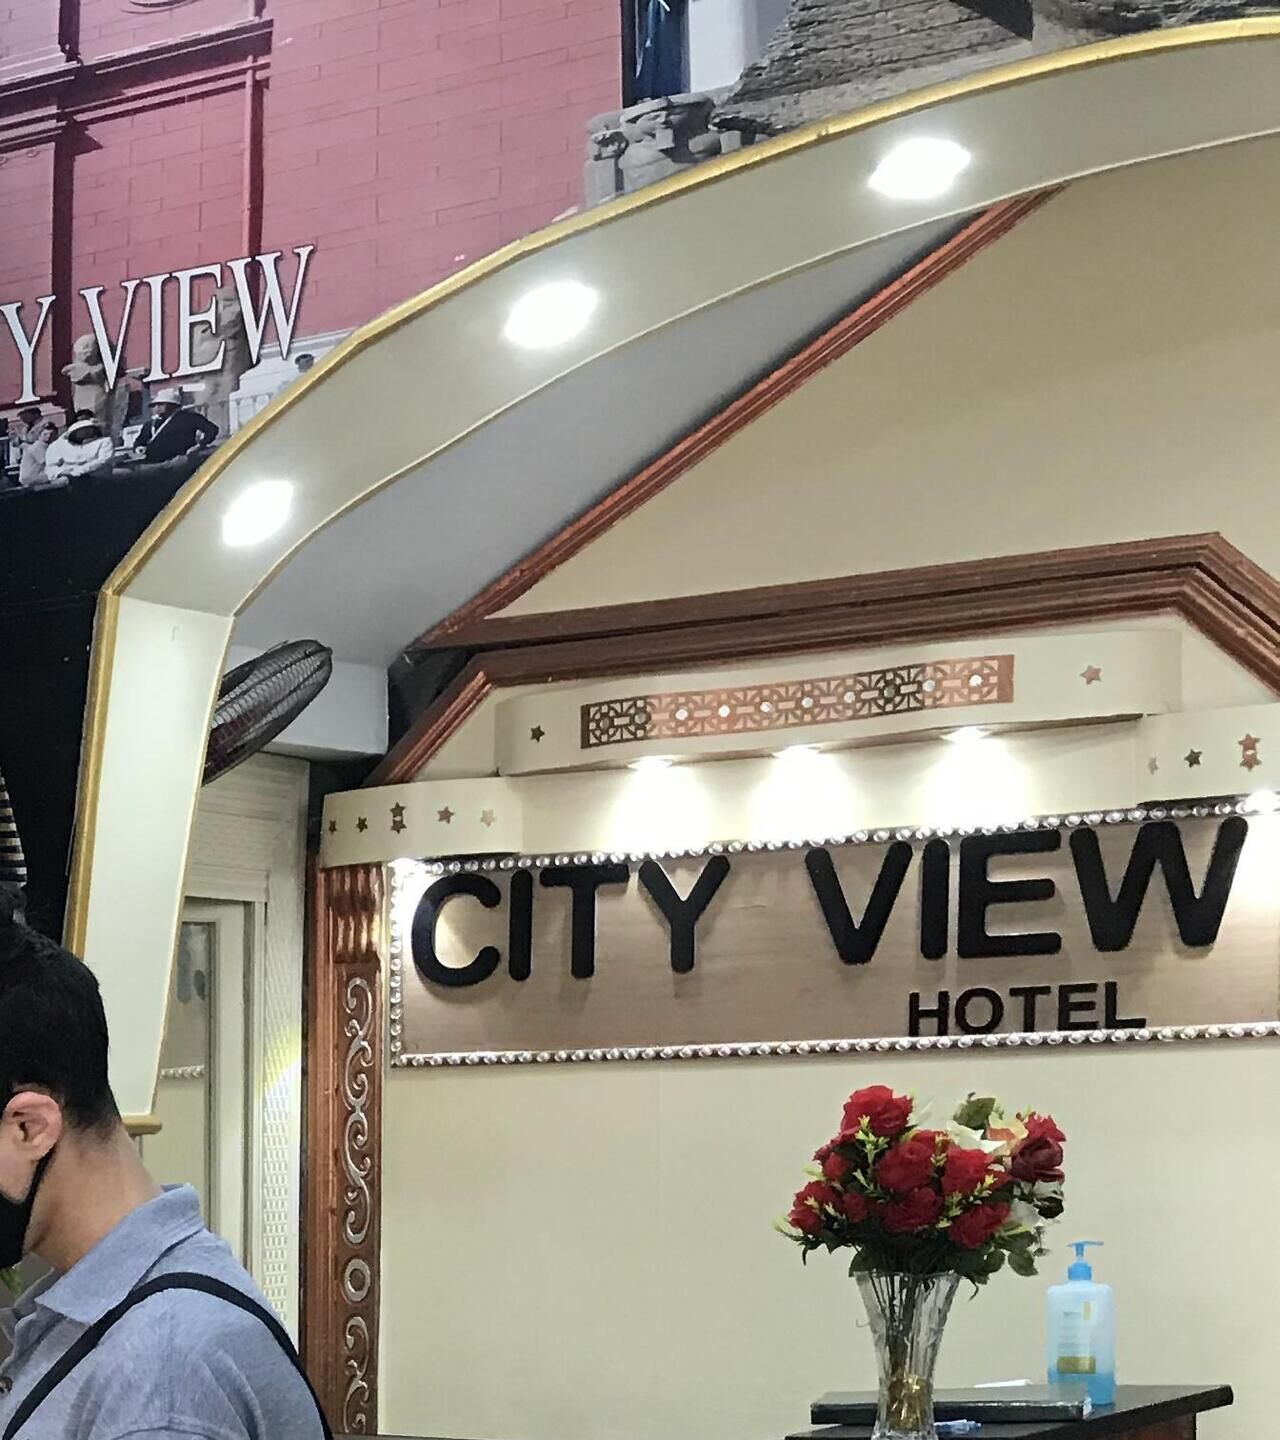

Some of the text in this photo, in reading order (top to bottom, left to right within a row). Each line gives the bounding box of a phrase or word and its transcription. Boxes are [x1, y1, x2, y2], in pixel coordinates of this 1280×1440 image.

[80, 245, 316, 392] VIEW
[411, 817, 1248, 988] CITY VIEW
[909, 981, 1146, 1038] HOTEL
